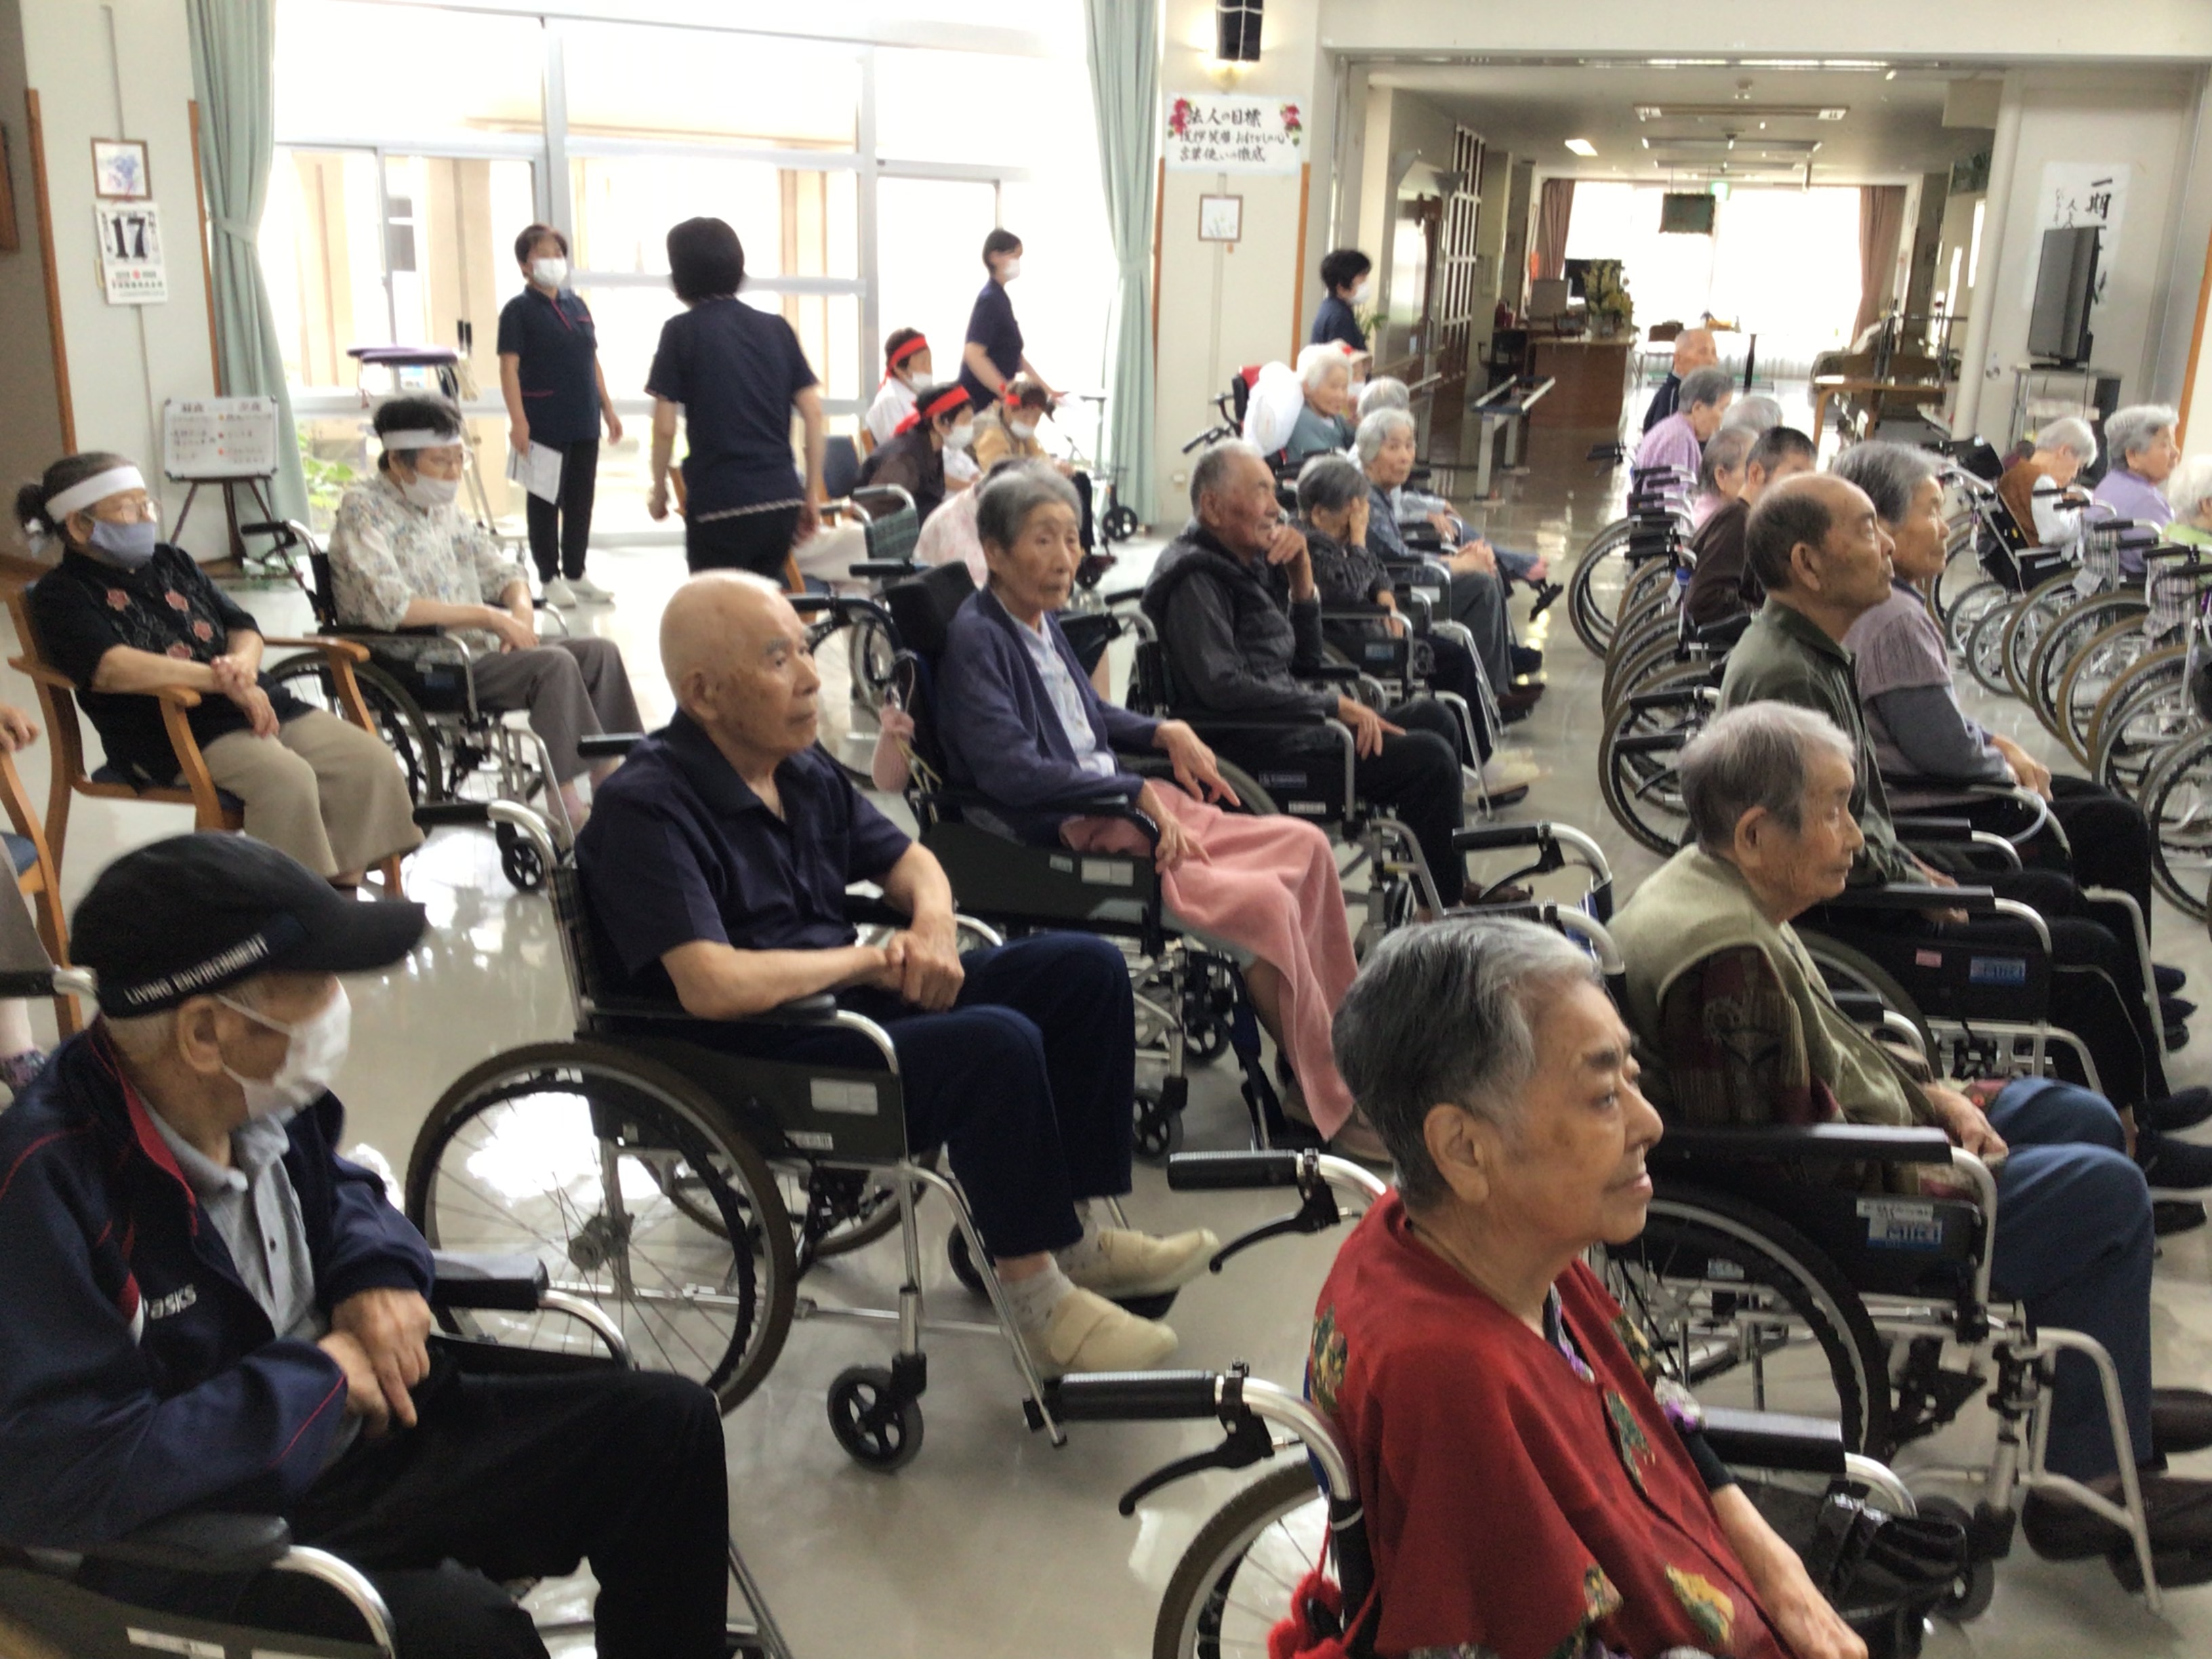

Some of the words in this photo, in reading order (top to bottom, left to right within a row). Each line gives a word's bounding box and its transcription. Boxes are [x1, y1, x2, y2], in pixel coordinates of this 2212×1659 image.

[1187, 106, 1261, 127] 法人の目標
[111, 216, 148, 260] 17
[123, 978, 174, 1005] LIVING
[171, 932, 269, 993] ENVIRONMENT
[150, 1283, 197, 1320] asics
